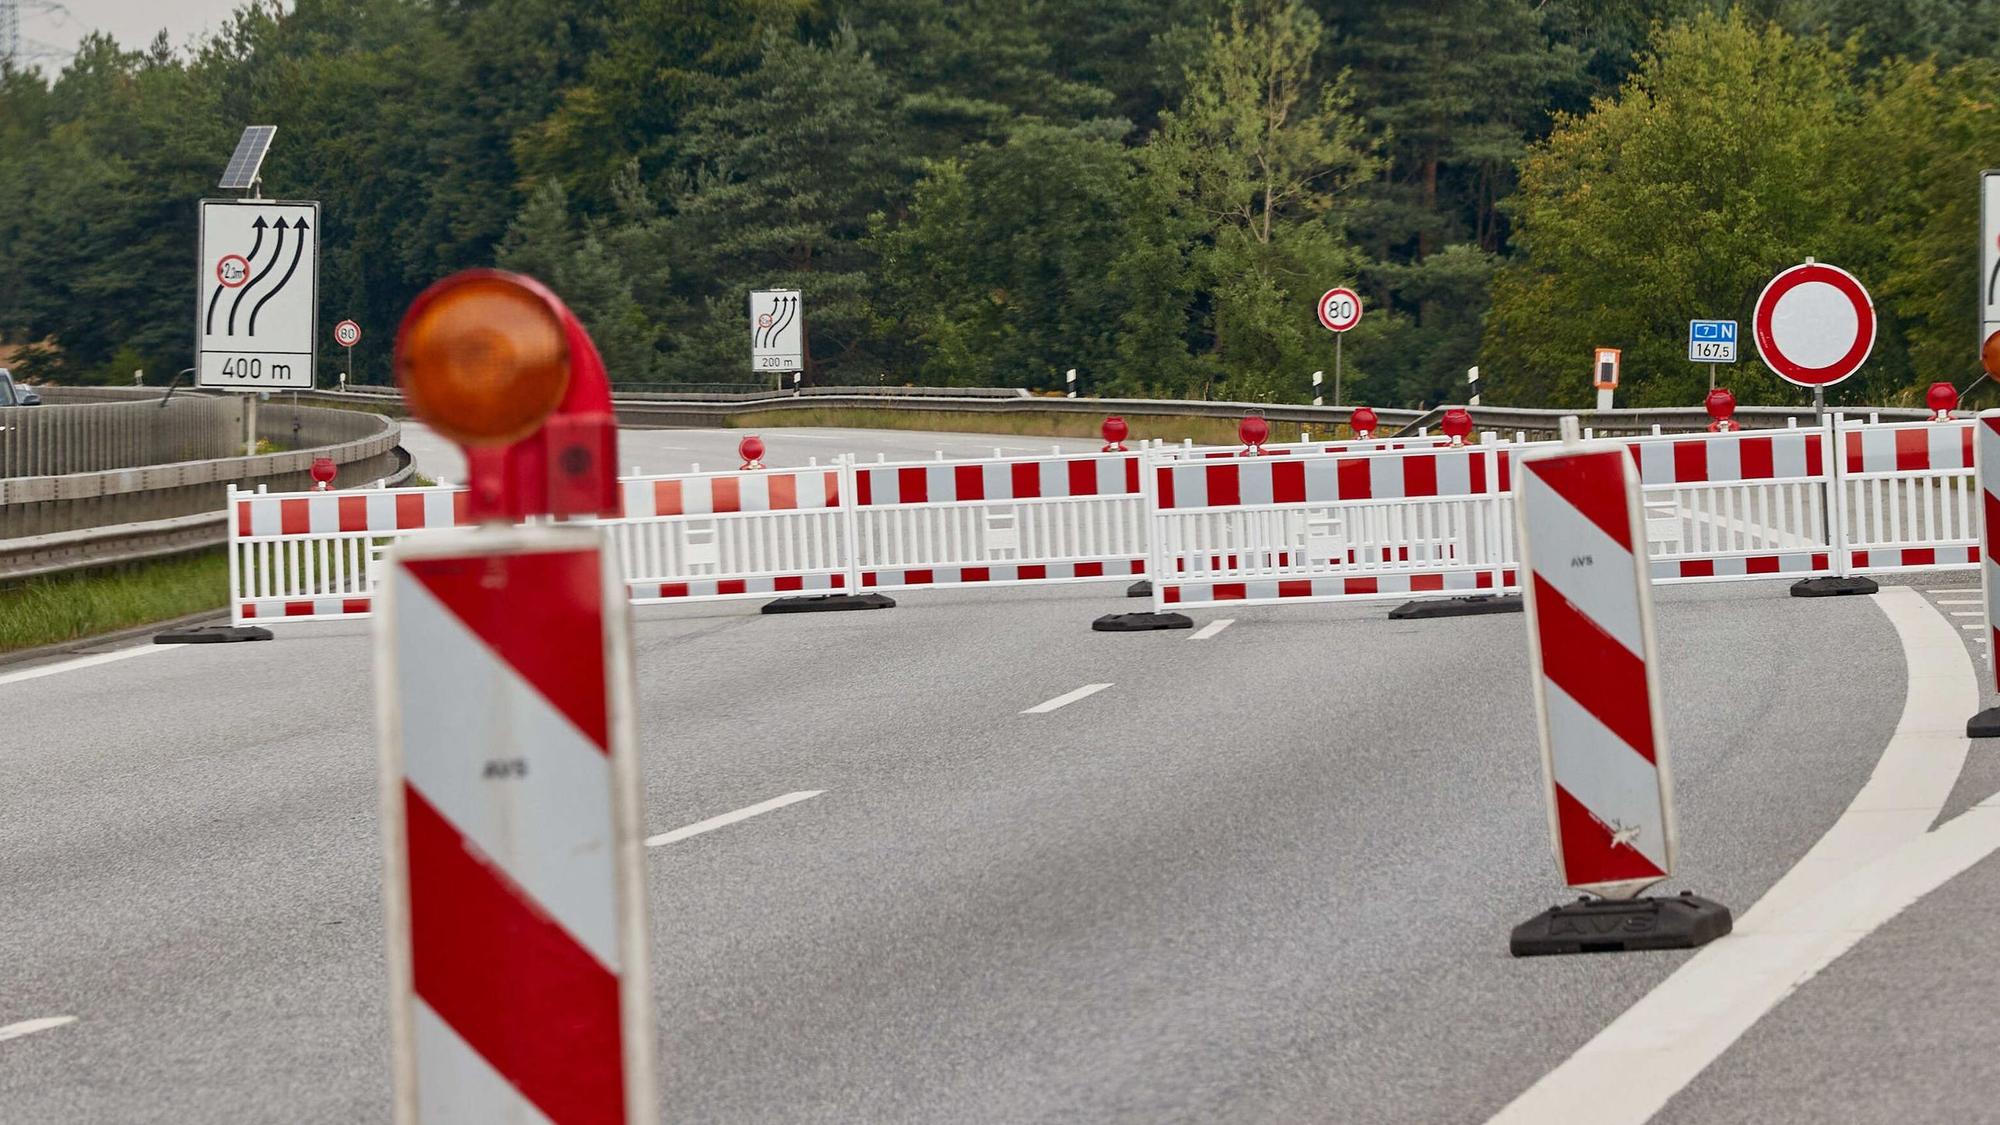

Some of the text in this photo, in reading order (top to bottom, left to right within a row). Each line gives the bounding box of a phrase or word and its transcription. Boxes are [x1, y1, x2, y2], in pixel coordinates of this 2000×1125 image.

[1329, 301, 1351, 318] 80
[341, 328, 355, 339] 80
[1703, 324, 1733, 339] 7 N
[222, 357, 291, 380] 400 m
[762, 357, 793, 367] 200 m
[1570, 554, 1595, 568] AVS
